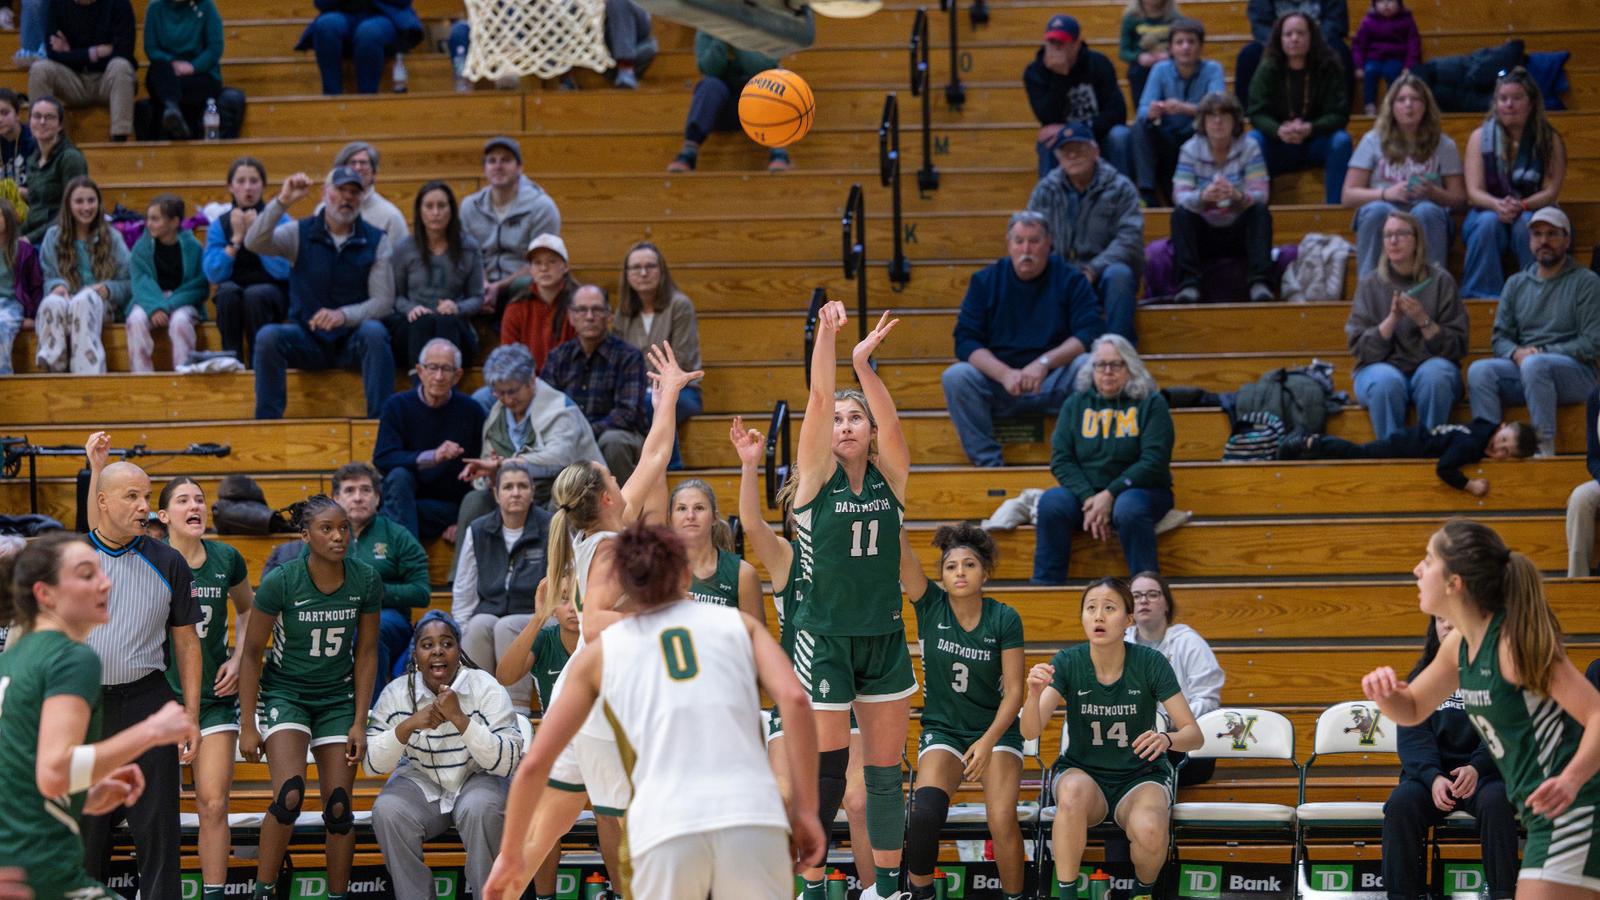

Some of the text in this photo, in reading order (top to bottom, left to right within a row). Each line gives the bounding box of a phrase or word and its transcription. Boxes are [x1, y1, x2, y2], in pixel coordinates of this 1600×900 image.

[934, 136, 949, 155] M
[904, 223, 918, 244] K
[835, 498, 891, 513] DARTMOUTH
[850, 519, 879, 557] 11
[298, 608, 357, 622] DARTMOUTH
[309, 627, 346, 657] 15
[937, 638, 991, 661] DARTMOUTH
[658, 626, 701, 682] 0
[951, 661, 970, 693] 3
[1080, 703, 1138, 717] DARTMOUTH
[1090, 721, 1129, 748] 14
[181, 879, 257, 899] D ank
[296, 876, 387, 897] TD ank
[435, 877, 453, 897] D
[556, 874, 576, 894] D
[973, 875, 1002, 889] Ba
[1185, 870, 1281, 892] TD Bank
[1315, 870, 1348, 891] TD
[1449, 869, 1482, 890] TD
